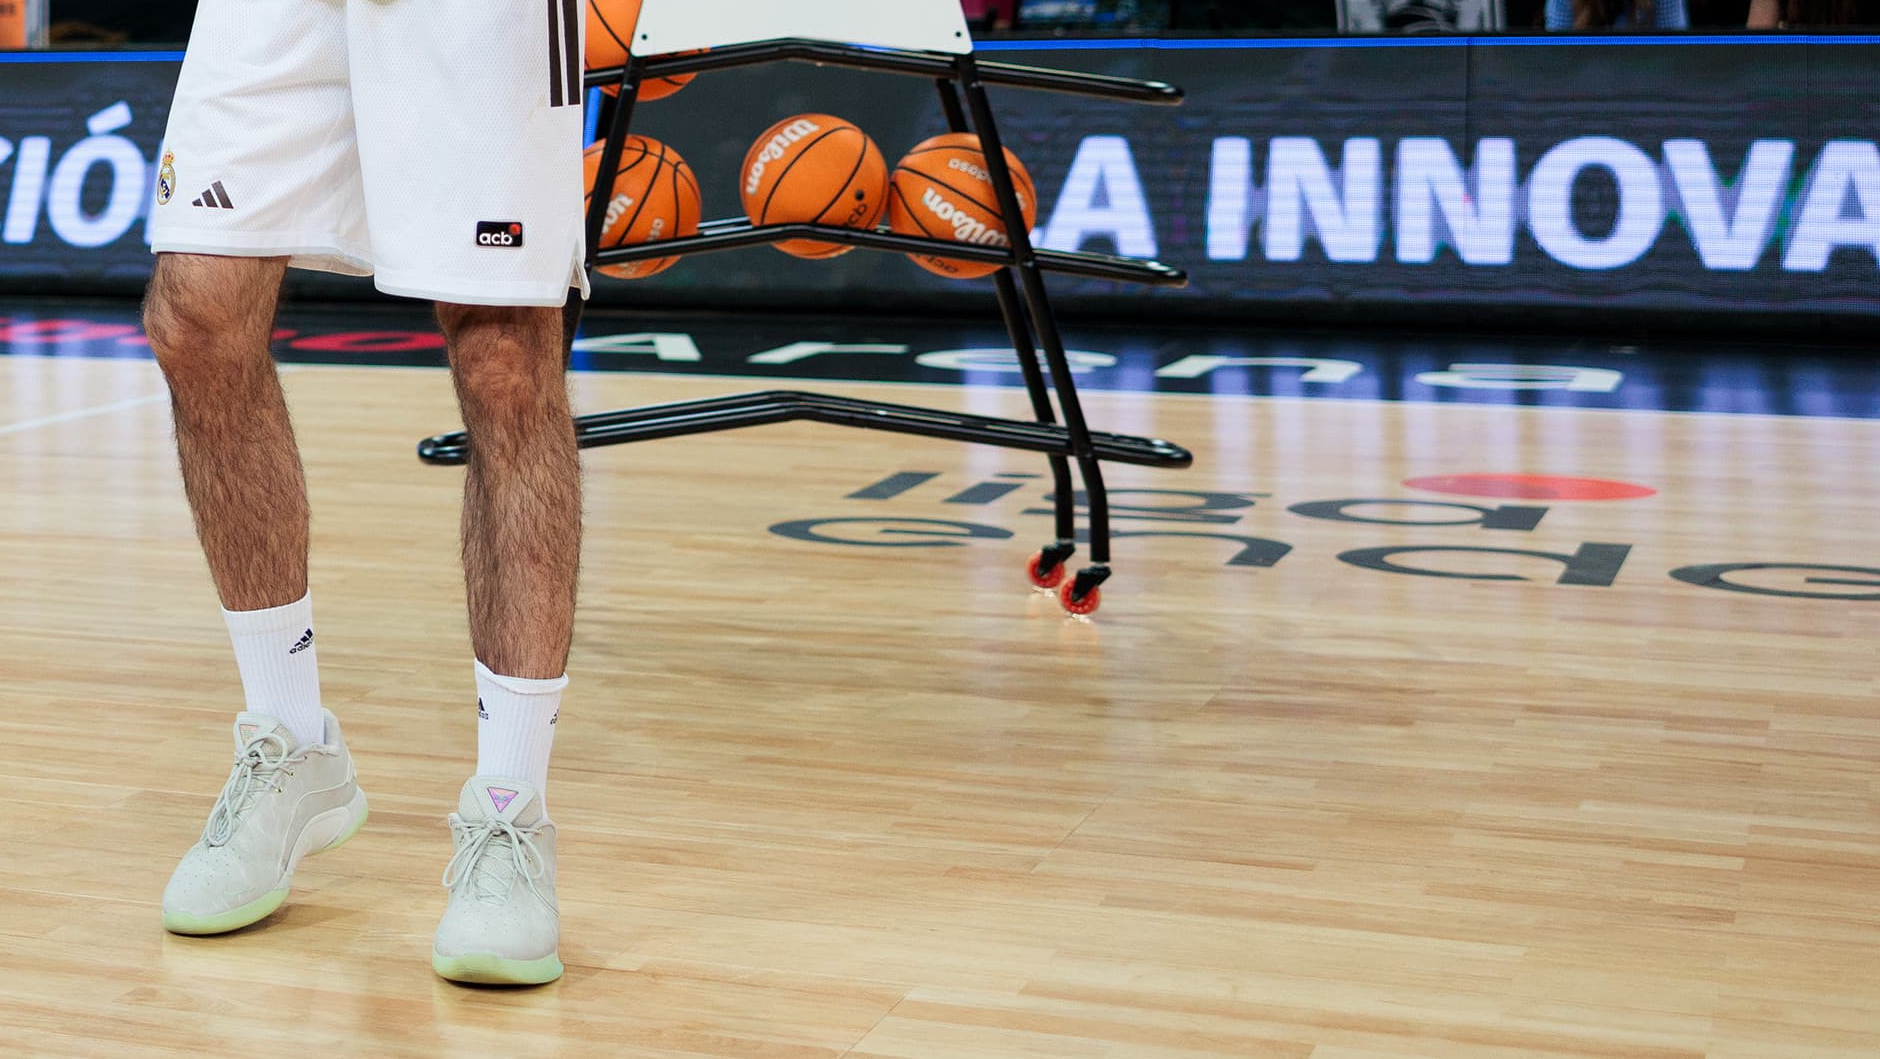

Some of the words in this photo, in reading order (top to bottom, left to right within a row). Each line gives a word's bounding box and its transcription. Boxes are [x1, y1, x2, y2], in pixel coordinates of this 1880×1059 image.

[745, 118, 820, 196] Wilson
[844, 203, 868, 227] cb
[1032, 135, 1159, 260] A
[1205, 134, 1880, 272] INNOVA
[479, 230, 513, 246] acb
[573, 331, 1625, 393] Arena
[845, 471, 1551, 532] liga
